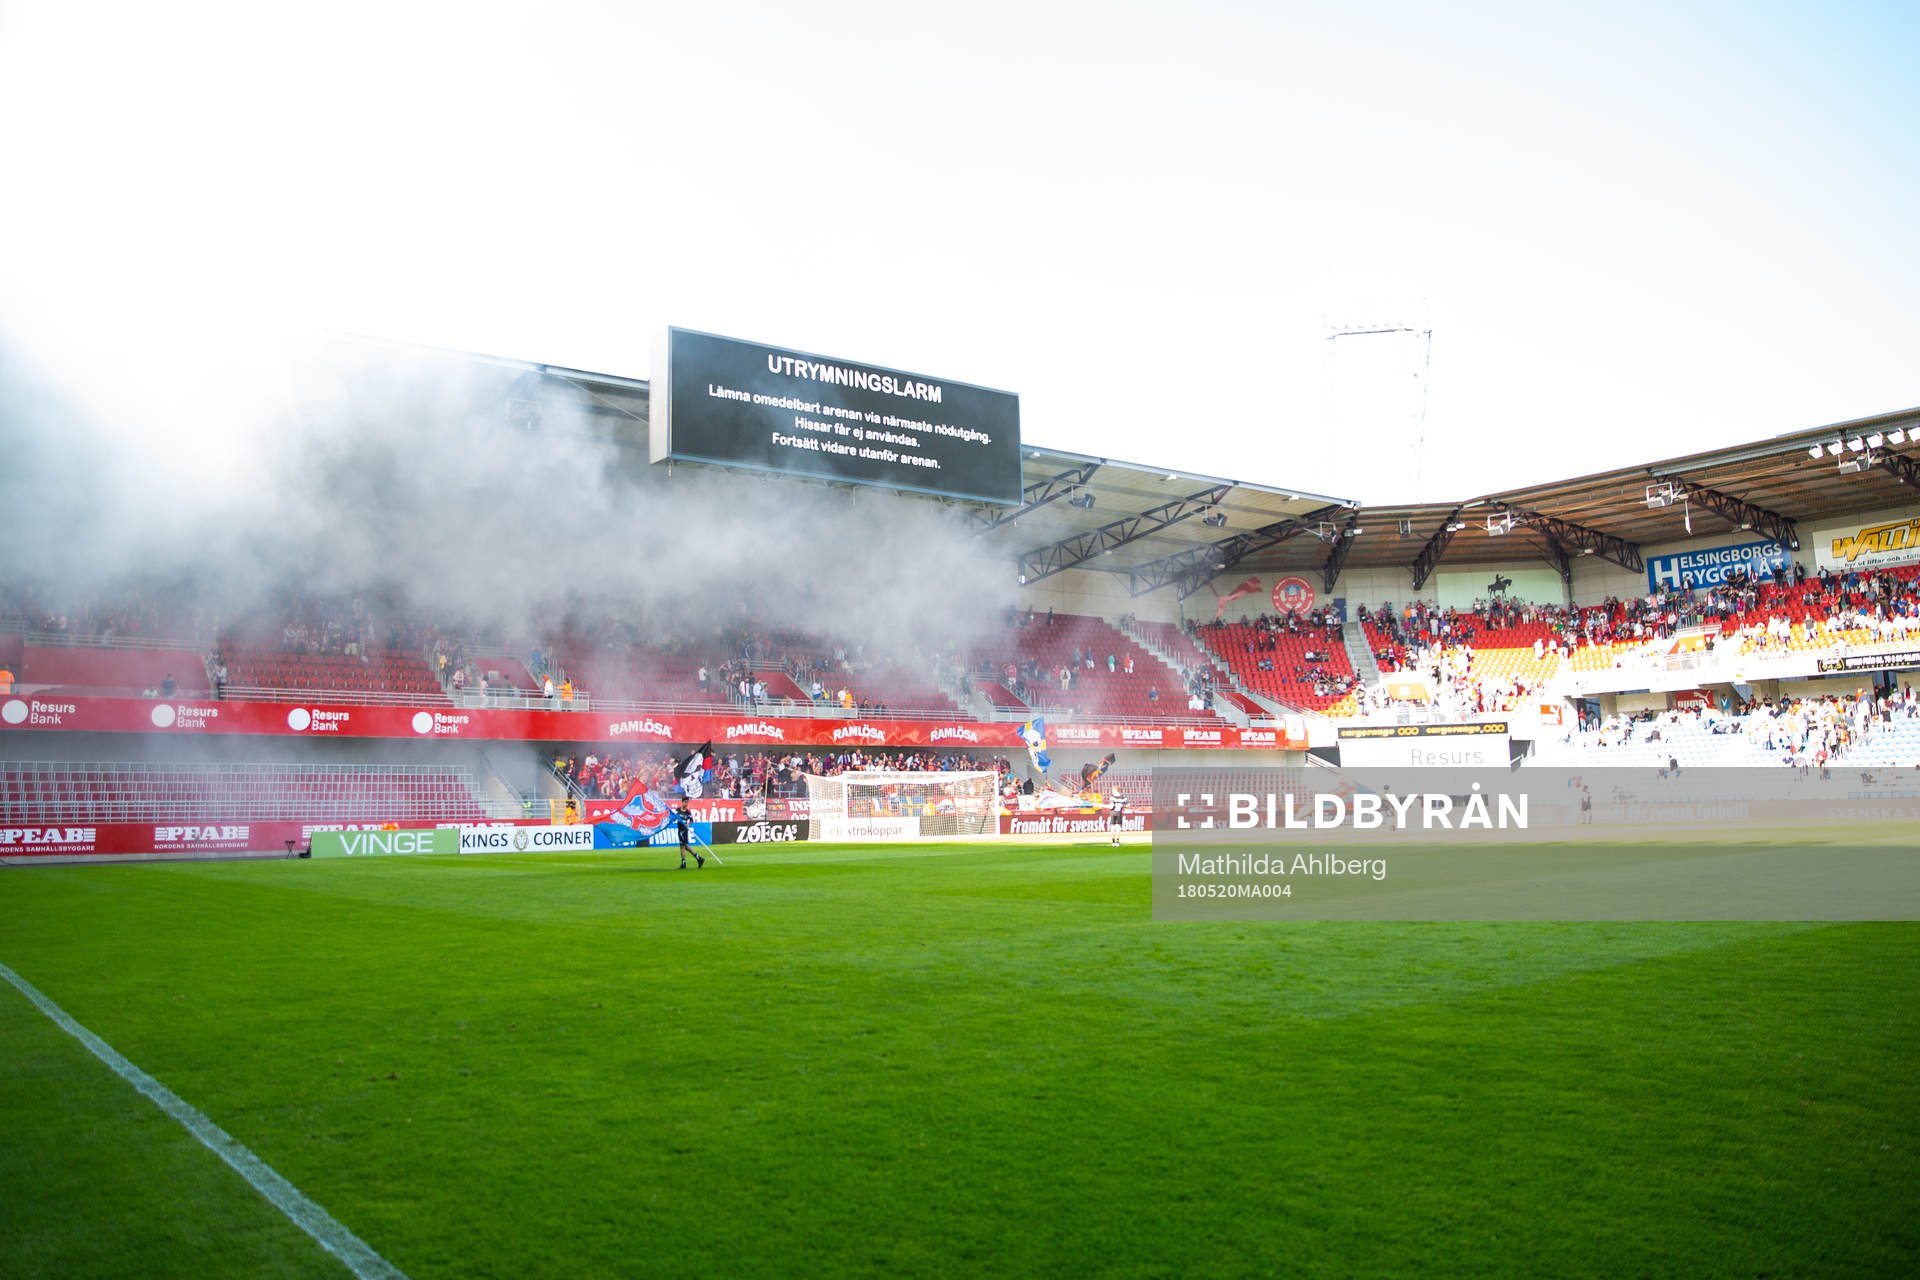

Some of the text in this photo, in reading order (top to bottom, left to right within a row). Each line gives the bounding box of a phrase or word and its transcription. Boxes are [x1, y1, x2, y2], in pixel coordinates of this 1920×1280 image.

[767, 353, 942, 403] UTRYMNINGSLARM
[708, 383, 992, 445] Lämna omedelbart arenan via närmaste nödutgång.
[794, 416, 921, 448] Hissar får ej användas.
[771, 432, 941, 470] Fortsätt vidare utanför arenan.
[1654, 542, 1783, 588] HELSINGBORGS
[31, 701, 76, 713] Resurs
[177, 705, 219, 717] Resurs
[311, 708, 350, 721] Resurs
[30, 712, 62, 725] Bank
[177, 716, 206, 728] Bank
[311, 720, 339, 732] Bank
[433, 712, 470, 724] Resurs
[433, 723, 459, 734] Bank
[609, 718, 672, 738] RAMLÖSA
[726, 721, 784, 740] RAMLÖSA
[833, 723, 885, 742] RAMLÖSA
[930, 725, 978, 743] RAMLÖSA
[1411, 748, 1484, 766] Resurs
[166, 825, 239, 841] PEAB
[1052, 815, 1068, 833] för
[1071, 816, 1105, 833] svensk
[3, 827, 84, 844] PEAB
[339, 832, 434, 856] VINGE
[461, 831, 592, 848] KINGS CORNER
